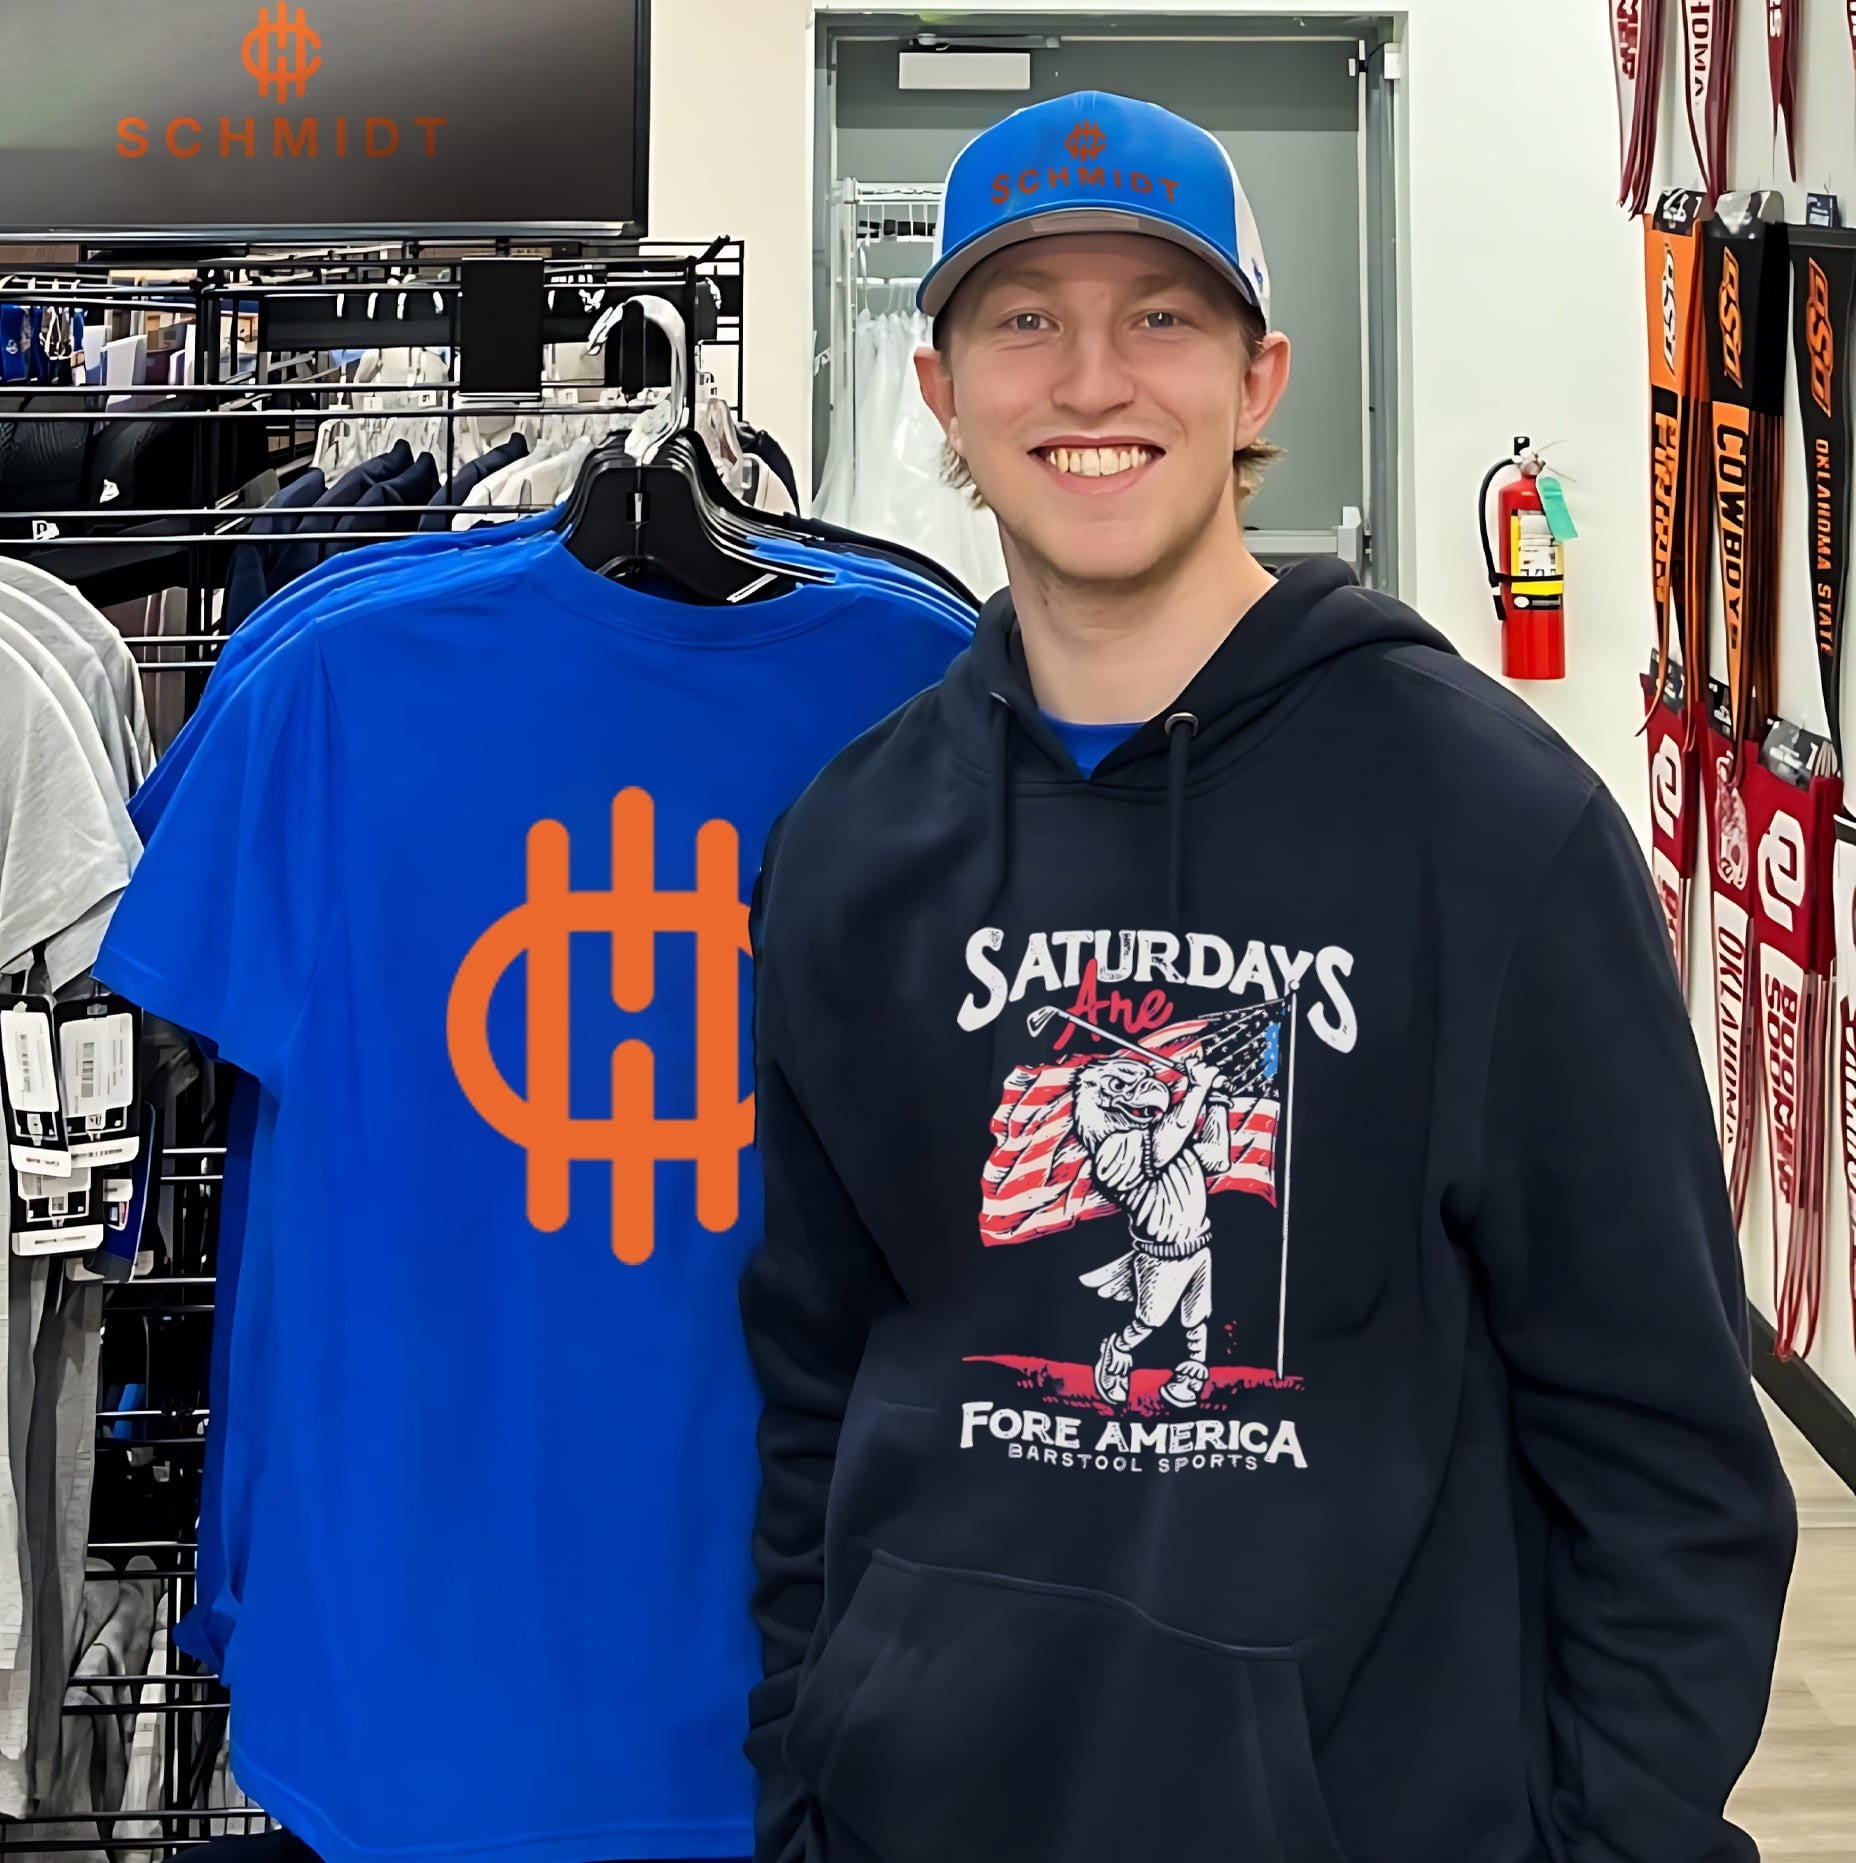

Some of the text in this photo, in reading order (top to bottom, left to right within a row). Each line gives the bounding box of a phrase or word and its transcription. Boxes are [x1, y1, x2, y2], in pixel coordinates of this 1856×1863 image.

[115, 116, 447, 158] SCHMIDT
[991, 167, 1180, 205] SCHMIDT
[1815, 438, 1833, 656] OKLAHOMA STATE
[956, 926, 1358, 1054] SATURDAYS
[1053, 958, 1174, 1051] Are
[1718, 925, 1745, 1144] OKLAHOMA
[960, 1401, 1308, 1468] FORE AMERICA
[1008, 1443, 1258, 1473] BARSTOOL SPORTS
